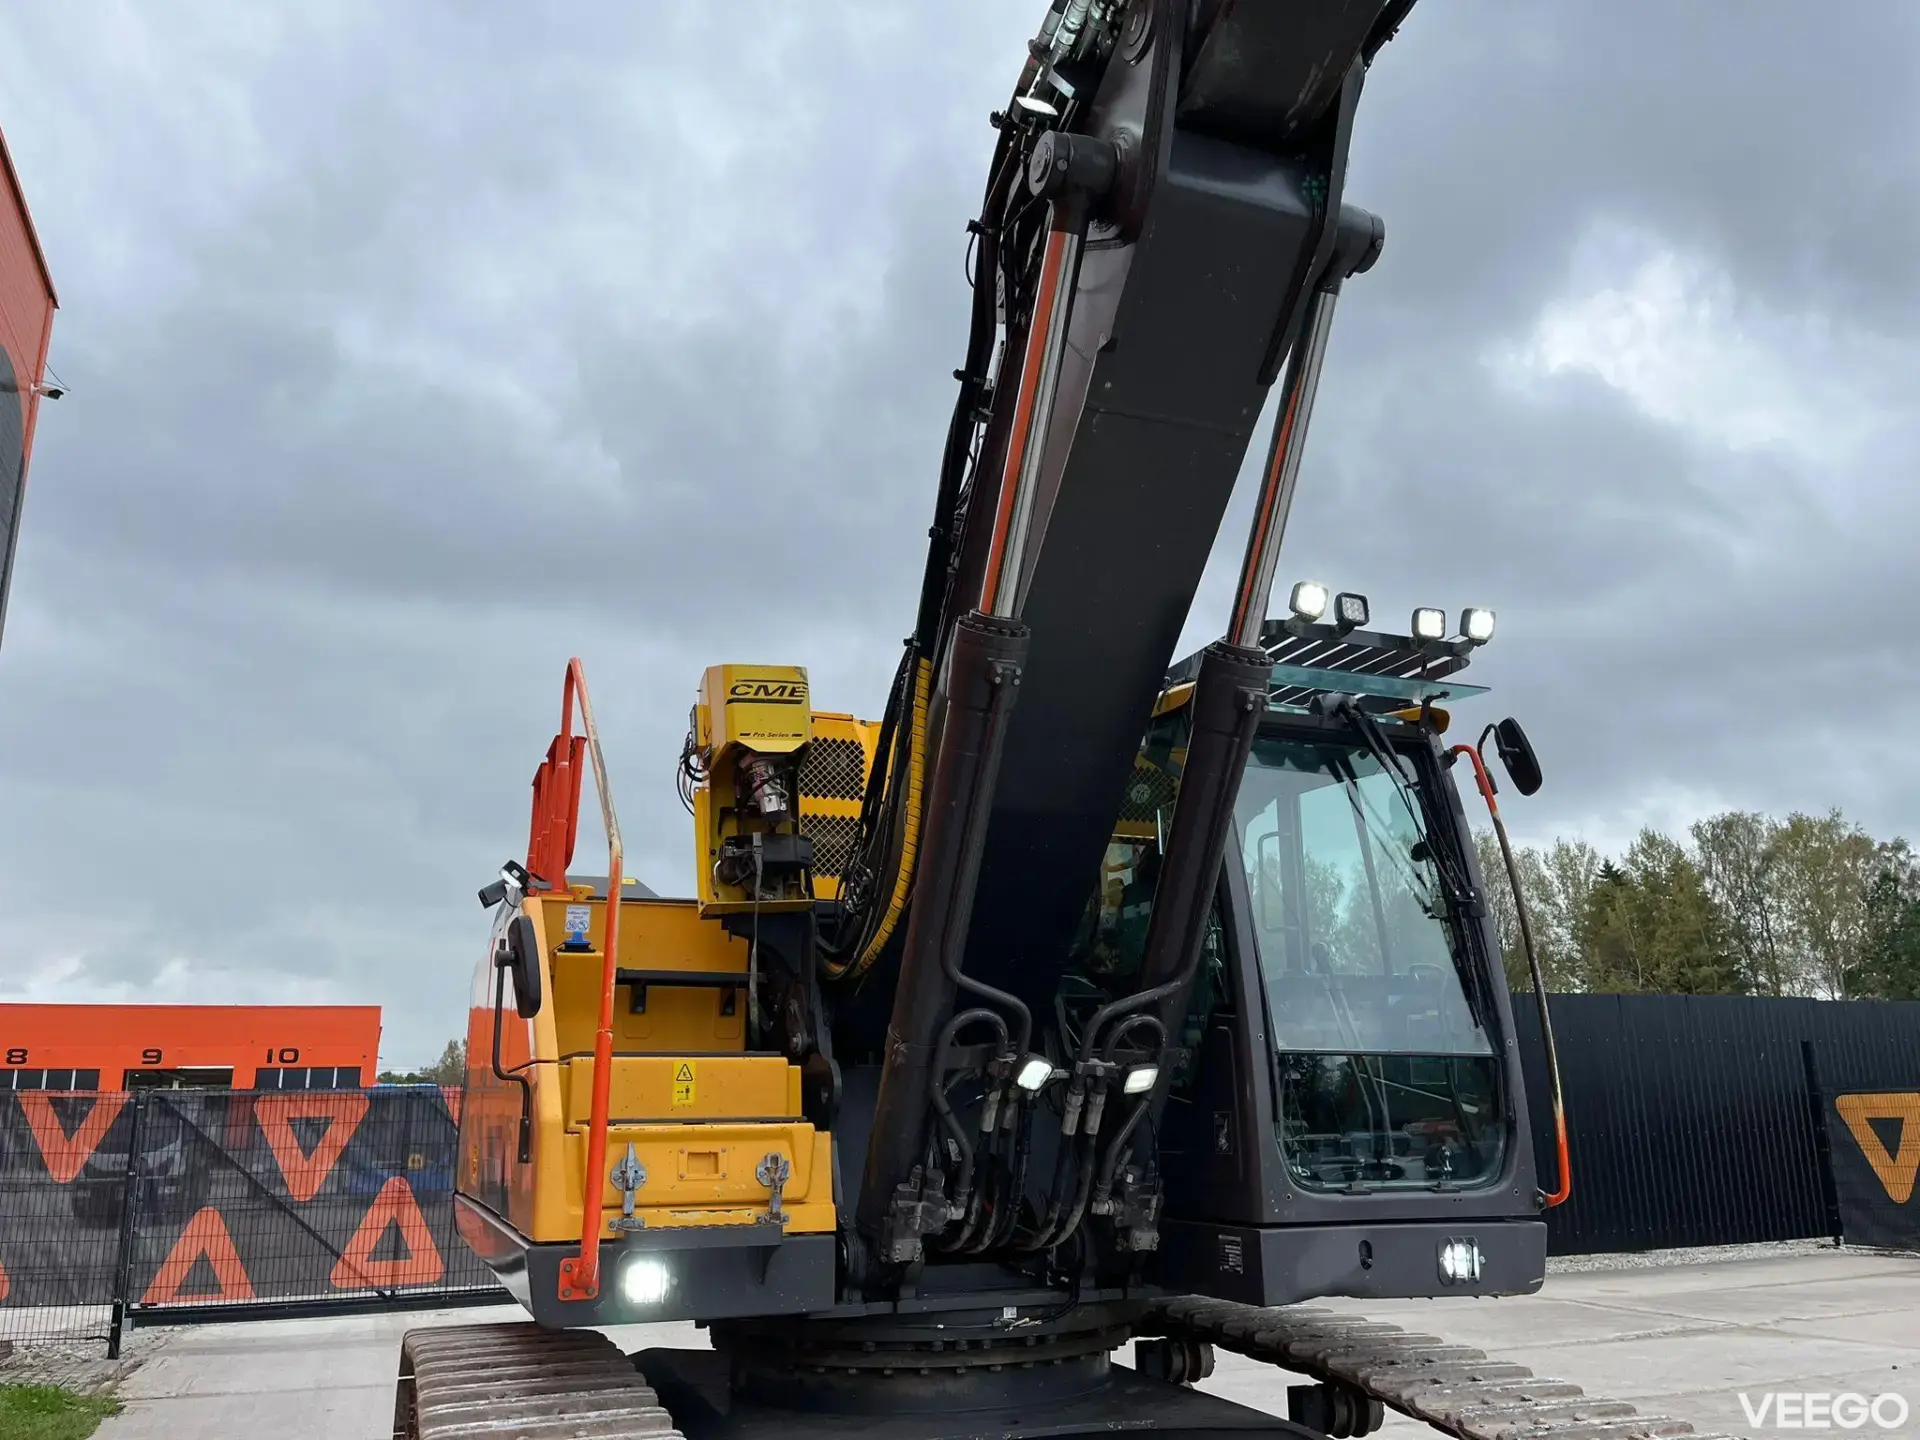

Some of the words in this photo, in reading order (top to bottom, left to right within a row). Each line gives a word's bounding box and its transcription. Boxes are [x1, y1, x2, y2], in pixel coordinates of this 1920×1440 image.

[730, 684, 808, 698] CME
[6, 1049, 28, 1064] 8
[142, 1048, 162, 1064] 9
[267, 1048, 299, 1063] 10
